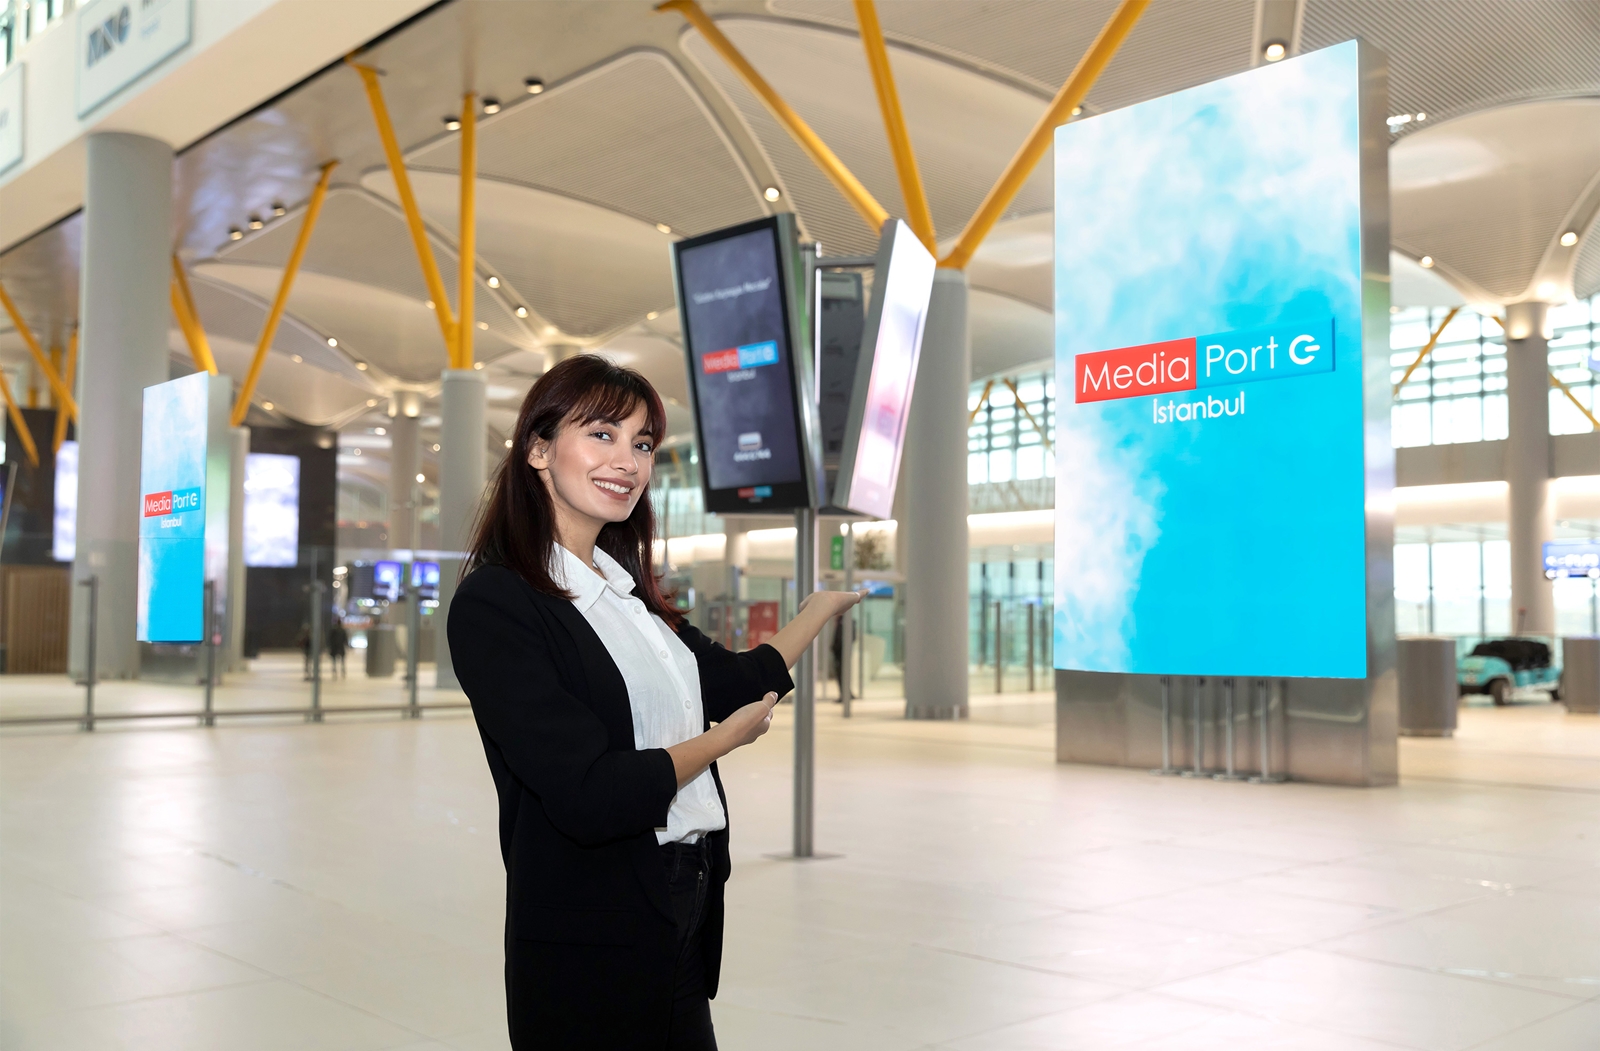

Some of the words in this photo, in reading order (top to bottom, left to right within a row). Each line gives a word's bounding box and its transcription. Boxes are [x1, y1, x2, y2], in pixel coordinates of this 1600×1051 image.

[1082, 351, 1190, 394] Media
[1206, 335, 1279, 377] Port
[145, 496, 171, 513] Media
[172, 492, 190, 509] Port
